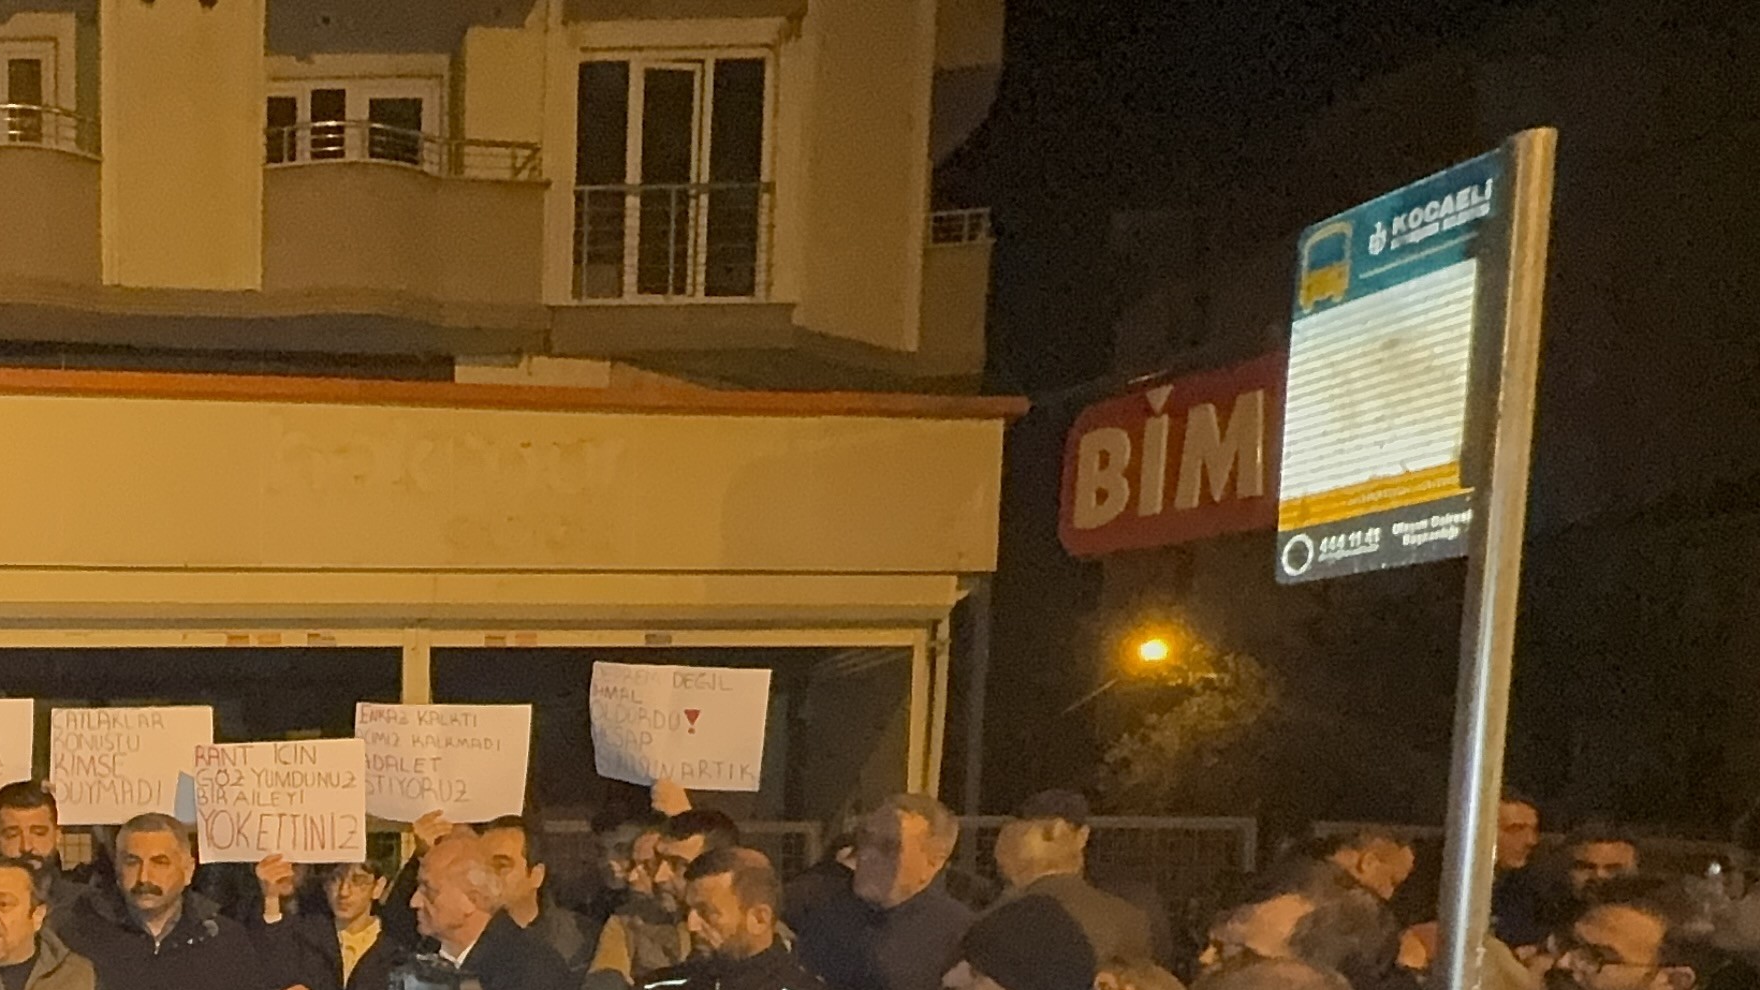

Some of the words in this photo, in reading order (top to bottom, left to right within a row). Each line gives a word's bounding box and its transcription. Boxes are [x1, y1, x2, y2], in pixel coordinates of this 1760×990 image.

[1072, 384, 1266, 531] BİM
[195, 745, 254, 767] RANT
[251, 767, 358, 789] YUMDUNUZ
[55, 778, 162, 806] DUYMADI
